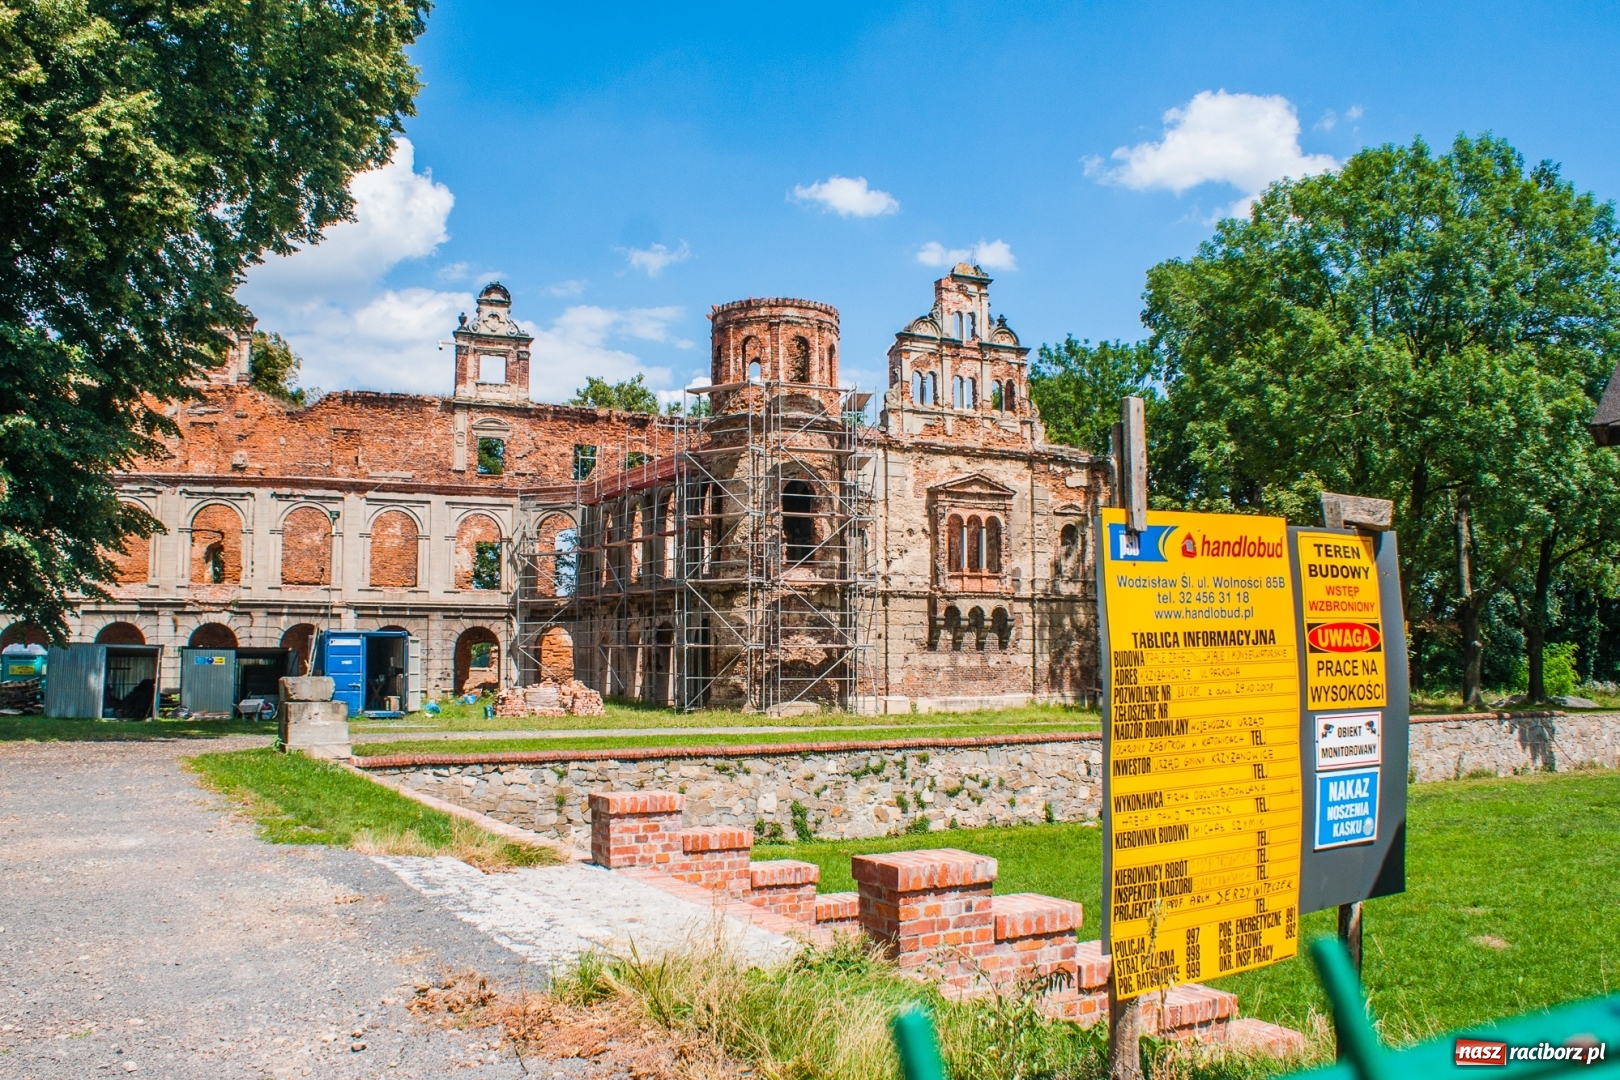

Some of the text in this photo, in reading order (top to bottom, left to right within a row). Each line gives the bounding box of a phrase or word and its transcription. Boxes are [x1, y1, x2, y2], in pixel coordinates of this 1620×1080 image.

[1200, 534, 1283, 558] handlobud
[1313, 543, 1361, 560] TEREN
[1116, 572, 1286, 589] Wodzisław Śl. ul. Wolności 85B
[1308, 564, 1370, 580] BUDOWY
[1157, 591, 1250, 604] tel. 32 456 31 18
[1325, 585, 1360, 599] WSTĘP
[1154, 606, 1254, 621] www.handlobud.pl
[1308, 600, 1375, 612] WZBRONIONY
[1132, 629, 1276, 649] TABLICA INFORMACYJNA
[1317, 628, 1373, 648] UWAGA
[1114, 650, 1145, 668] BUDOWA
[1317, 659, 1378, 677] PRACE NA
[1114, 668, 1138, 686] ADRES
[1114, 684, 1171, 704] POZWOLENIE NR
[1310, 680, 1384, 703] WYSOKOŚCI
[1114, 702, 1168, 723] ZGŁOSZENIE NR
[1114, 718, 1189, 741] NADZÓR BUDOWLANY
[1250, 729, 1266, 747] TEL.
[1337, 725, 1362, 738] OBIEKT
[1321, 743, 1377, 759] MONITOROWANY
[1113, 757, 1151, 777] INWESTOR
[1253, 763, 1268, 779] TEL.
[1328, 777, 1370, 802] NAKAZ
[1114, 791, 1164, 813] WYKONAWCA
[1254, 796, 1270, 813] TEL.
[1326, 801, 1370, 821] NOSZENIA
[1115, 823, 1190, 850] KIEROWNIK BUDOWY
[1332, 819, 1363, 838] KASKU
[1256, 830, 1270, 847] TEL.
[1256, 847, 1270, 865] TEL.
[1115, 858, 1189, 887] KIEROWNICY ROBÓT
[1256, 864, 1269, 881] TEL.
[1114, 877, 1193, 905] INSPEKTOR NADZORU
[1216, 887, 1252, 906] JERZY
[1255, 897, 1269, 915] TEL.
[1218, 905, 1296, 938] POG. ENERGETYCZNE 991
[1114, 927, 1201, 959] POLICJA 997
[1218, 921, 1297, 956] POG. GAZOWE 992
[1185, 944, 1201, 962] 998
[1218, 954, 1234, 972] OKR.
[1236, 949, 1252, 968] INSP.
[1253, 944, 1274, 964] PRACY
[1118, 975, 1136, 996] POG.
[1185, 961, 1201, 980] 999
